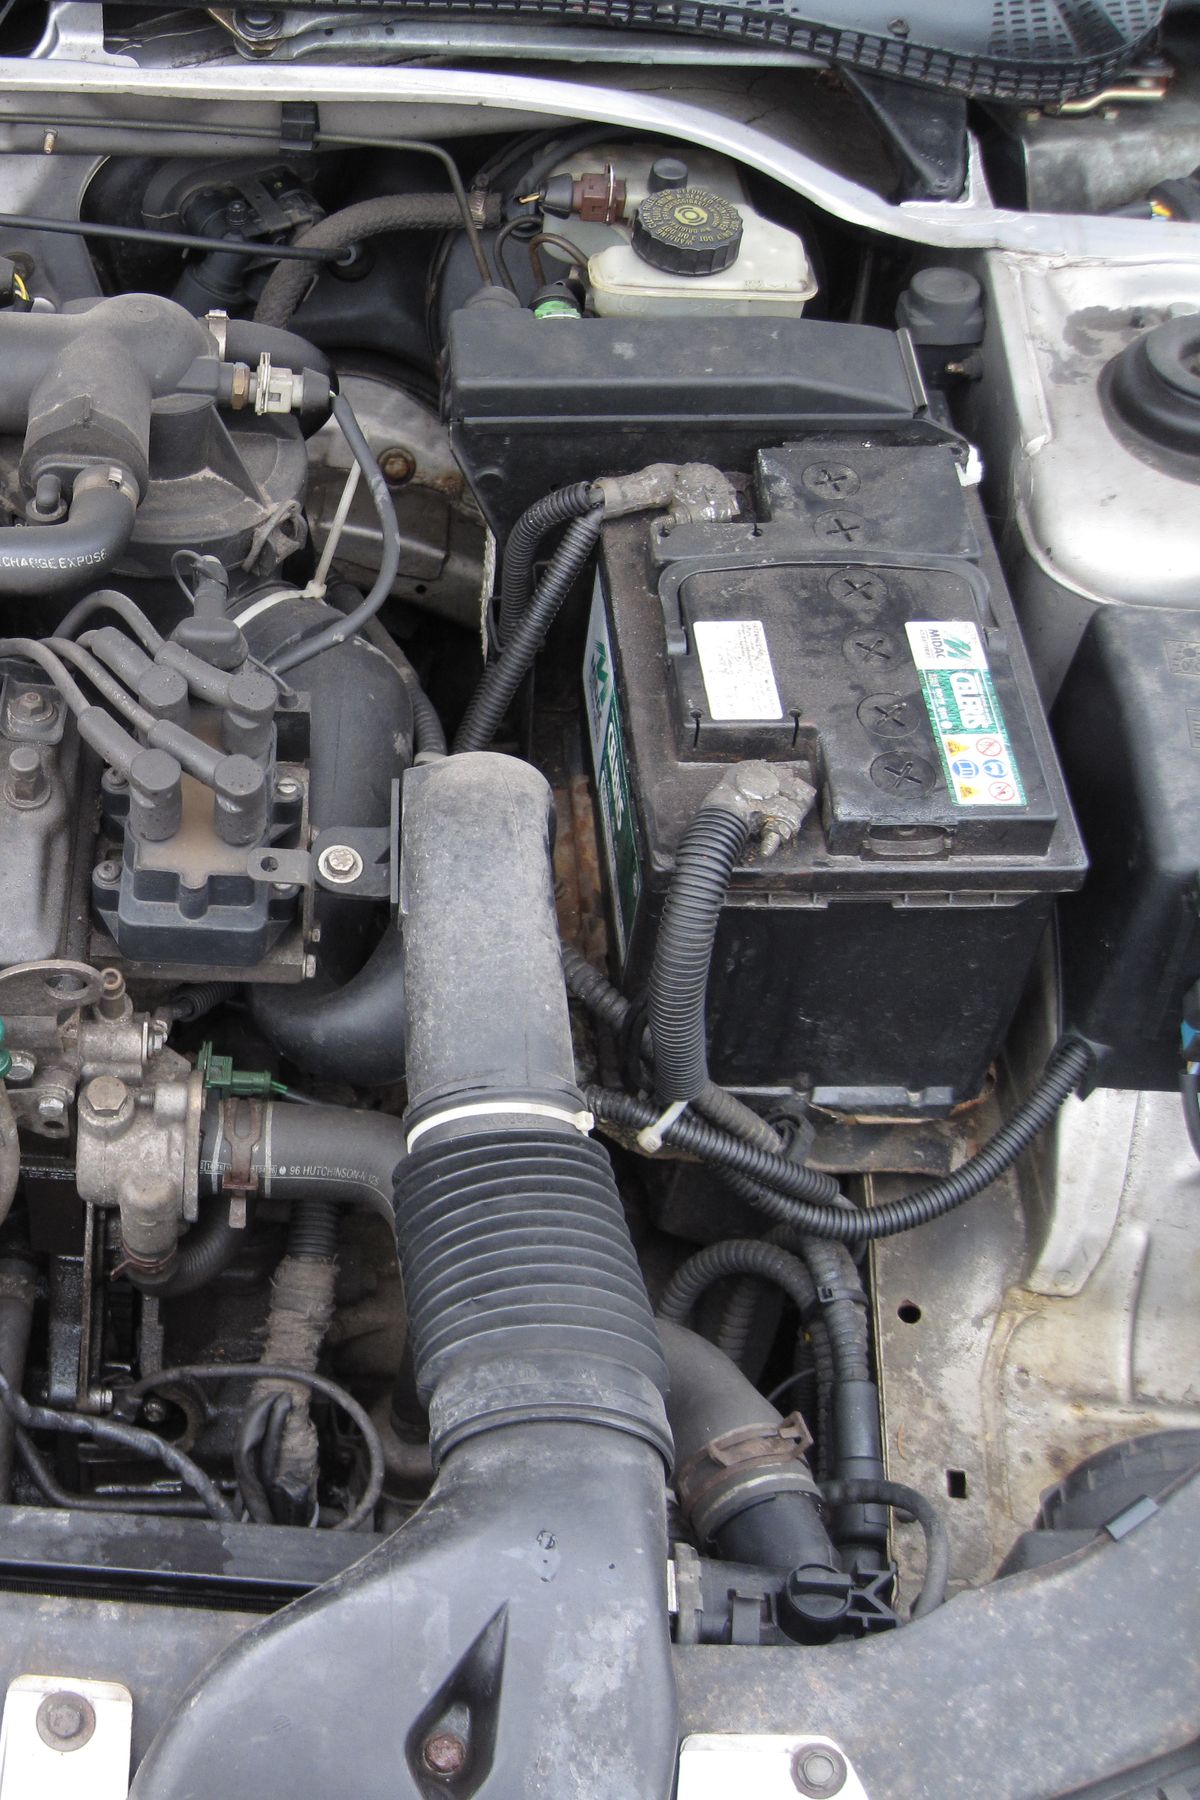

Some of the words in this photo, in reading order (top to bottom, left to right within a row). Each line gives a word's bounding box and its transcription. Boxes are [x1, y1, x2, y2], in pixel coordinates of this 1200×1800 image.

[656, 228, 694, 246] WARNING
[699, 234, 714, 242] DOT
[2, 556, 57, 569] CHARGE
[928, 628, 946, 659] MIDAC
[289, 1165, 301, 1176] 96
